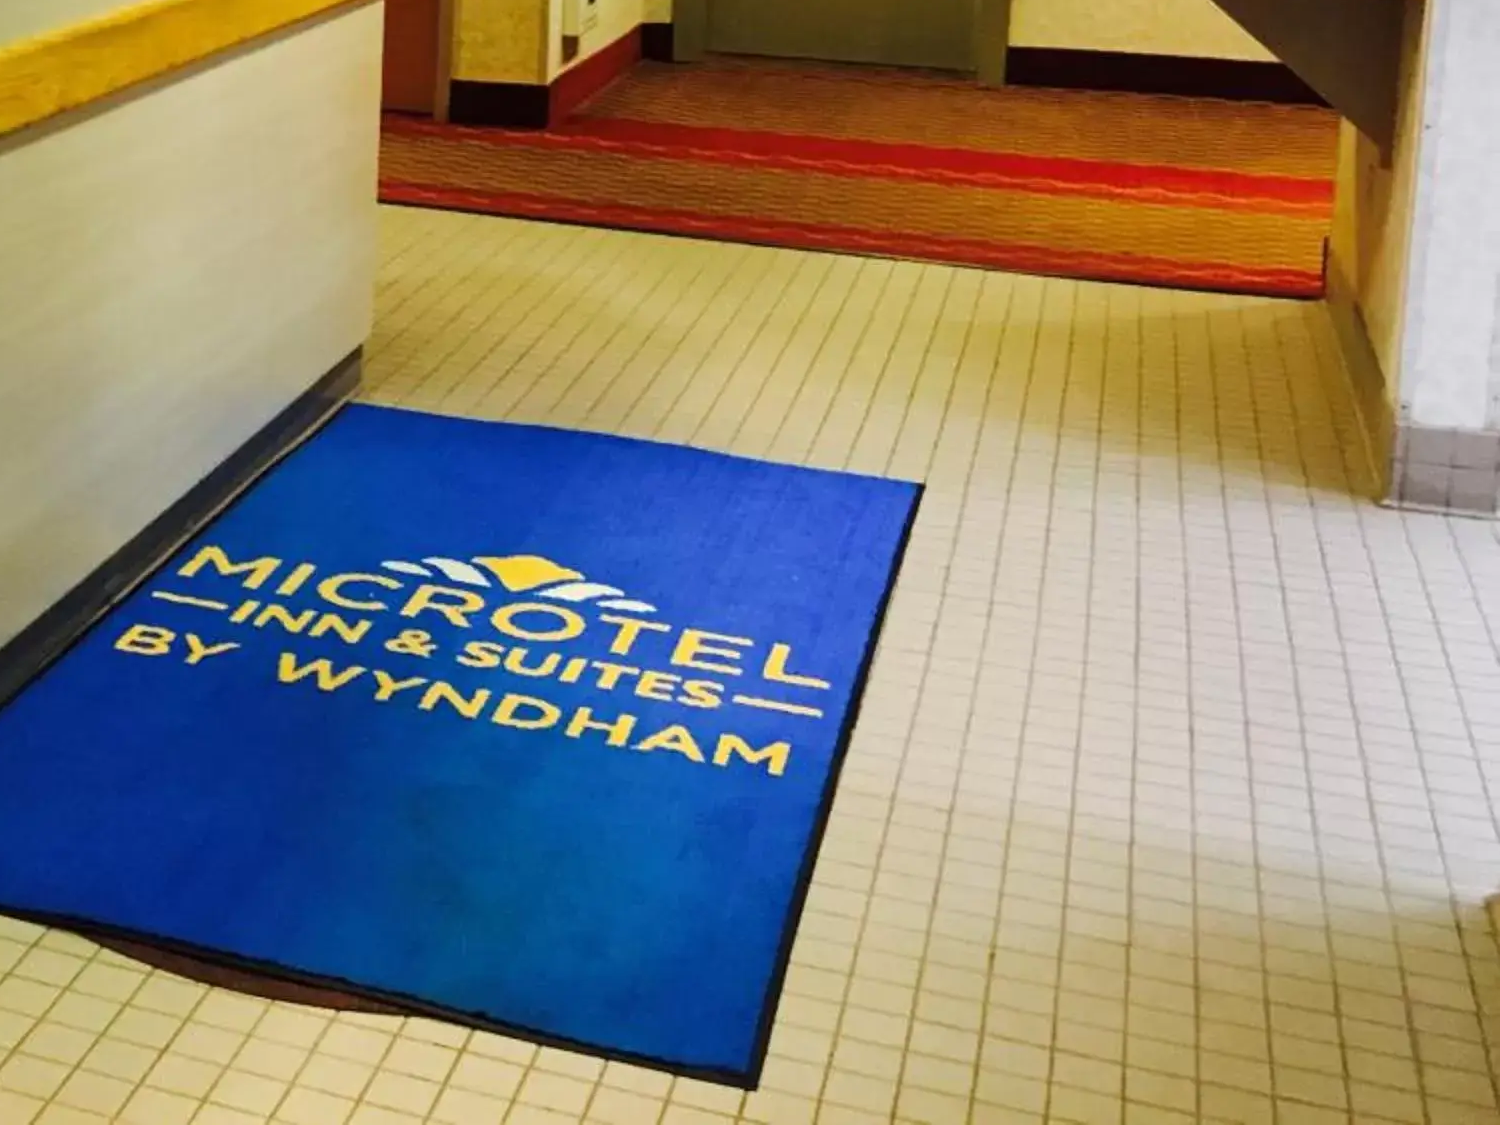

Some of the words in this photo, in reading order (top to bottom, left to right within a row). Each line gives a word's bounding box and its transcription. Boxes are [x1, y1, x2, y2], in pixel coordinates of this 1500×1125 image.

[176, 544, 832, 690] MICROTEL
[228, 599, 373, 644] INN
[384, 629, 439, 659] &
[456, 640, 726, 709] SUITES
[113, 623, 242, 665] BY
[277, 651, 792, 777] WYNDHAM
